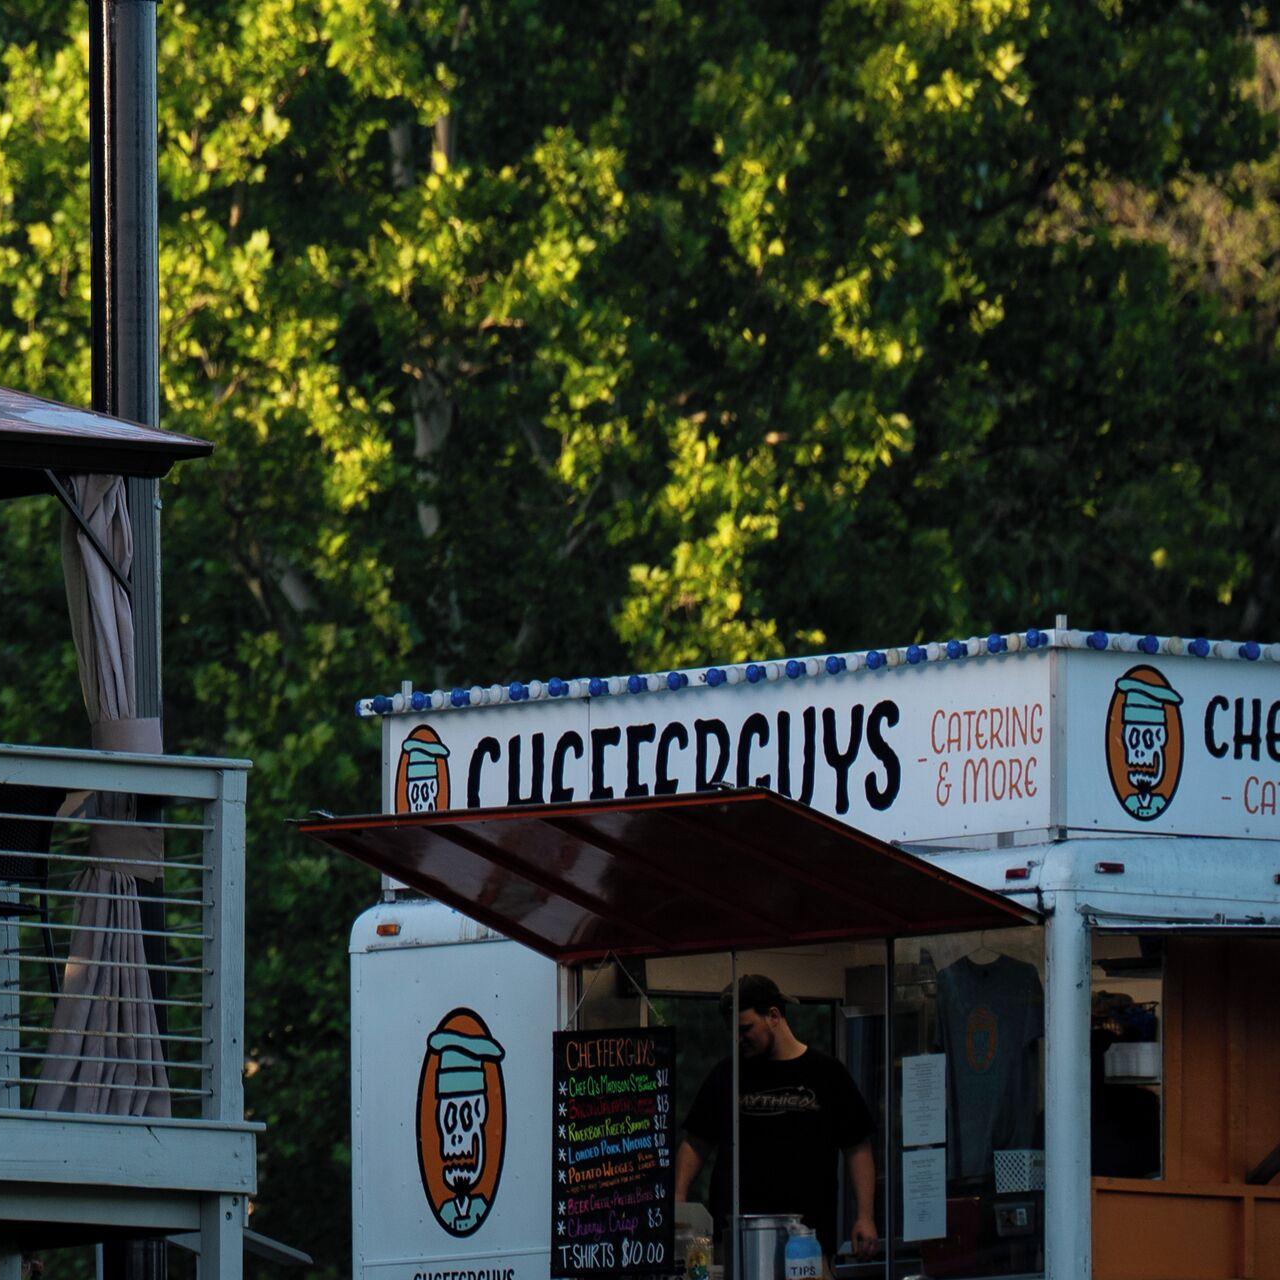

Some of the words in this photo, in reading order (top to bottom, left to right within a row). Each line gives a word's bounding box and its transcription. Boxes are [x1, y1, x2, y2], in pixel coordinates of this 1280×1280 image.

[930, 703, 1044, 755] CATERING
[936, 761, 952, 808] &
[962, 756, 1038, 806] MORE
[1243, 775, 1280, 816] CA
[566, 1038, 657, 1071] CHEFFERGUYS
[656, 1067, 669, 1087] $12
[656, 1094, 670, 1113] $13
[653, 1114, 668, 1130] $12
[568, 1167, 602, 1185] POTATO
[654, 1184, 666, 1200] $6
[647, 1207, 663, 1229] $3
[558, 1242, 615, 1269] T-SHIRTS
[621, 1237, 665, 1268] $10.00
[790, 1265, 817, 1276] TIPS
